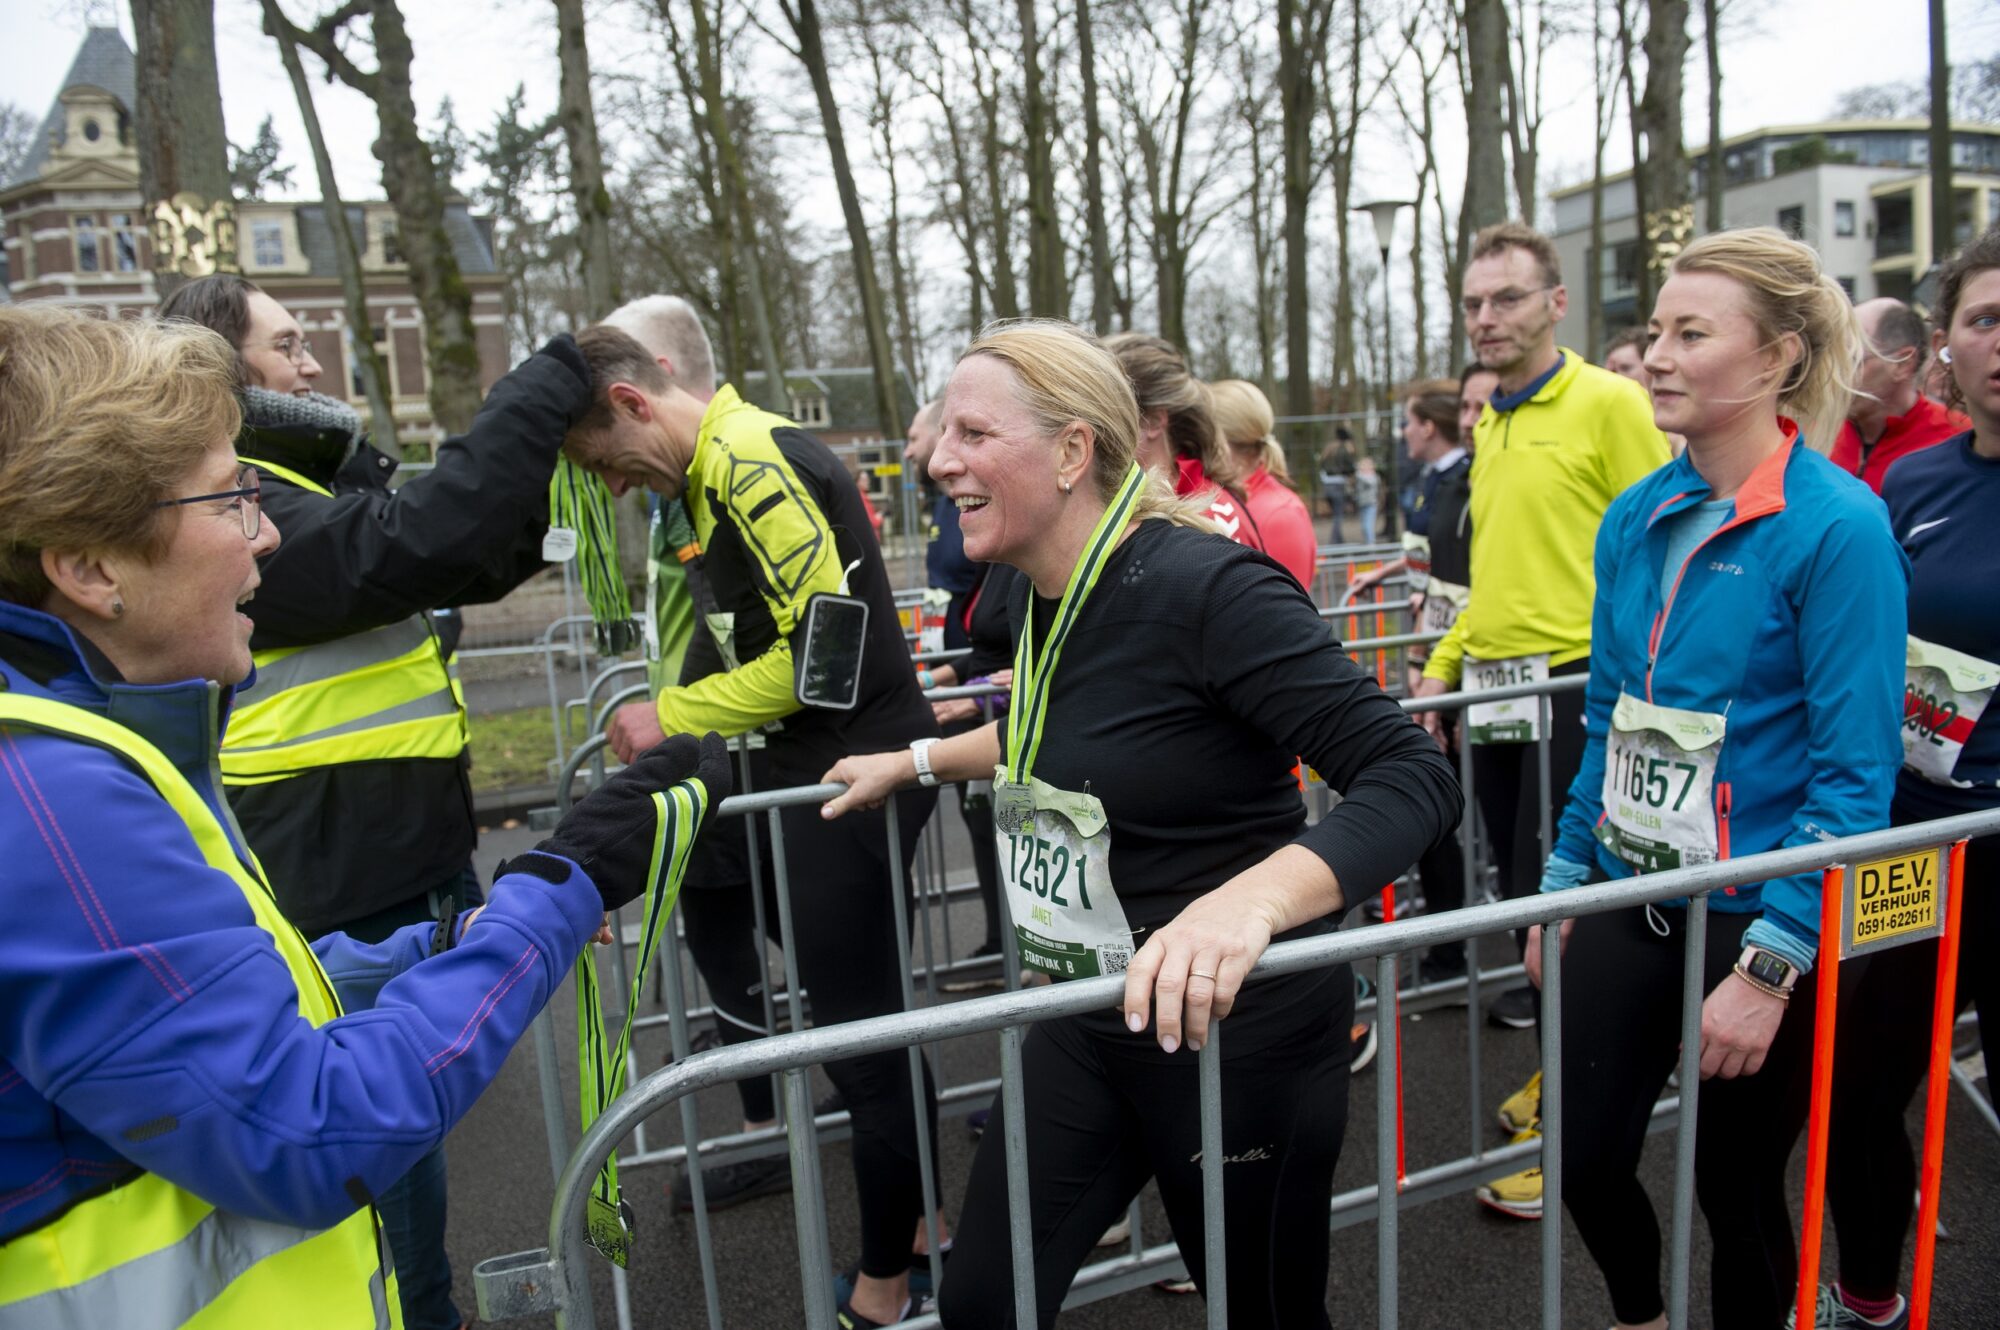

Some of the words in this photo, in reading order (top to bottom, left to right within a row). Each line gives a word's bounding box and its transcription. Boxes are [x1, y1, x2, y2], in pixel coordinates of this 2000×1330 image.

[1613, 745, 1698, 812] 11657
[1008, 834, 1093, 910] 12521
[1649, 855, 1658, 870] A
[1861, 857, 1932, 900] D.E.V.
[1031, 903, 1053, 927] JANET
[1861, 889, 1931, 916] VERHUUR
[1857, 906, 1931, 936] 0591-622611
[1024, 949, 1061, 971] STARTVAK
[1065, 960, 1075, 974] B
